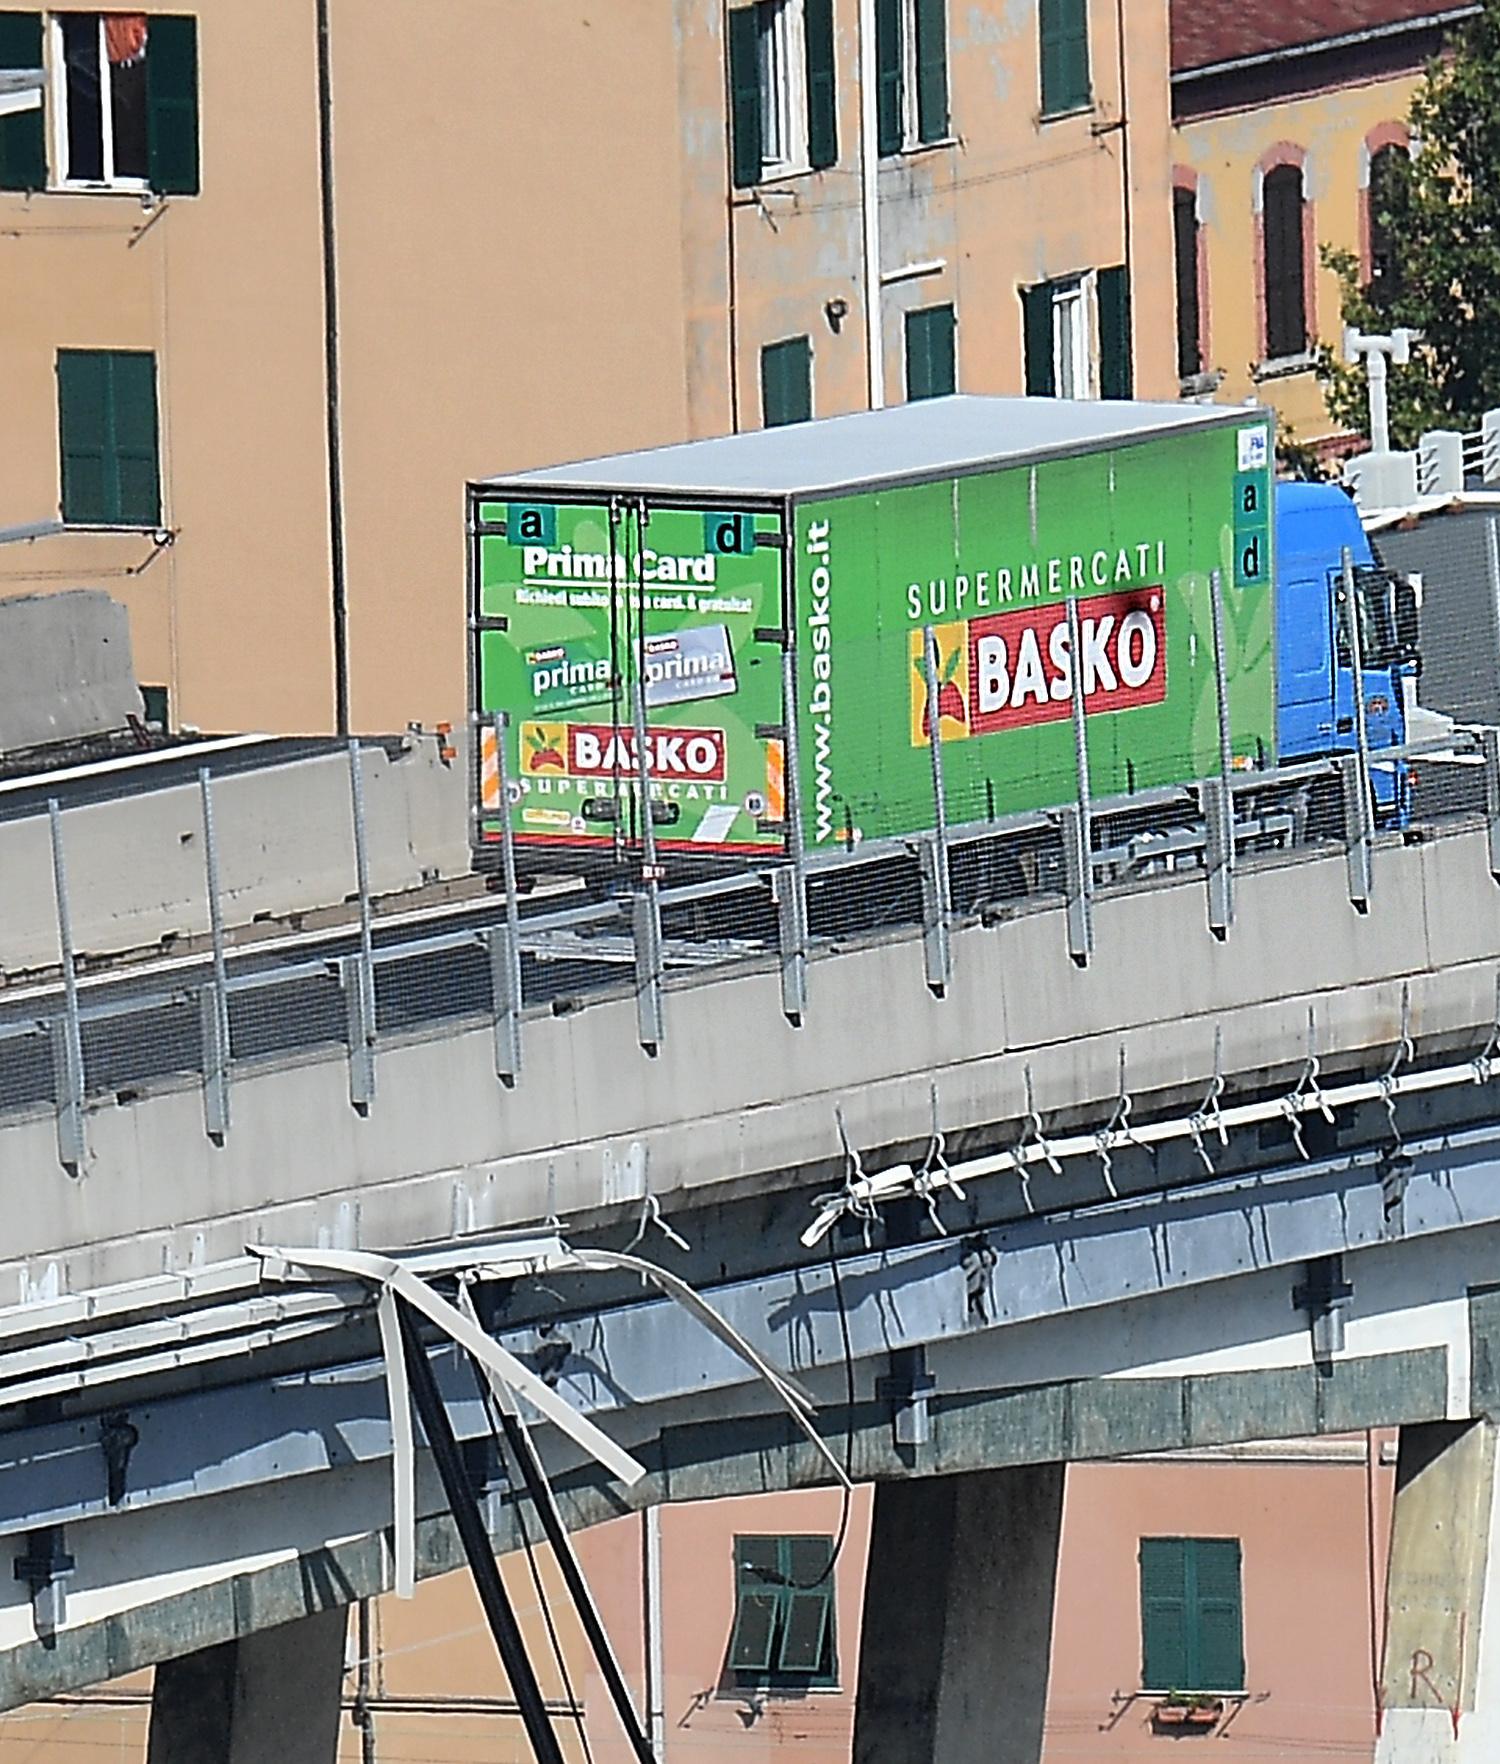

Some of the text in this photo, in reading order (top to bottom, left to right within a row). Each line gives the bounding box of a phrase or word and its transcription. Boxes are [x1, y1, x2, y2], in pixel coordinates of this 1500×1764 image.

[1243, 484, 1257, 512] a
[520, 510, 542, 538] a
[716, 514, 742, 553] d
[523, 544, 716, 582] Prima Card
[1243, 535, 1258, 577] d
[907, 540, 1165, 619] SUPERMERCATI
[532, 659, 611, 698] prima
[645, 653, 725, 689] prima
[806, 518, 833, 843] www.basko.it
[977, 610, 1157, 714] BASKO
[575, 731, 718, 774] BASKO
[1409, 1649, 1443, 1703] R
